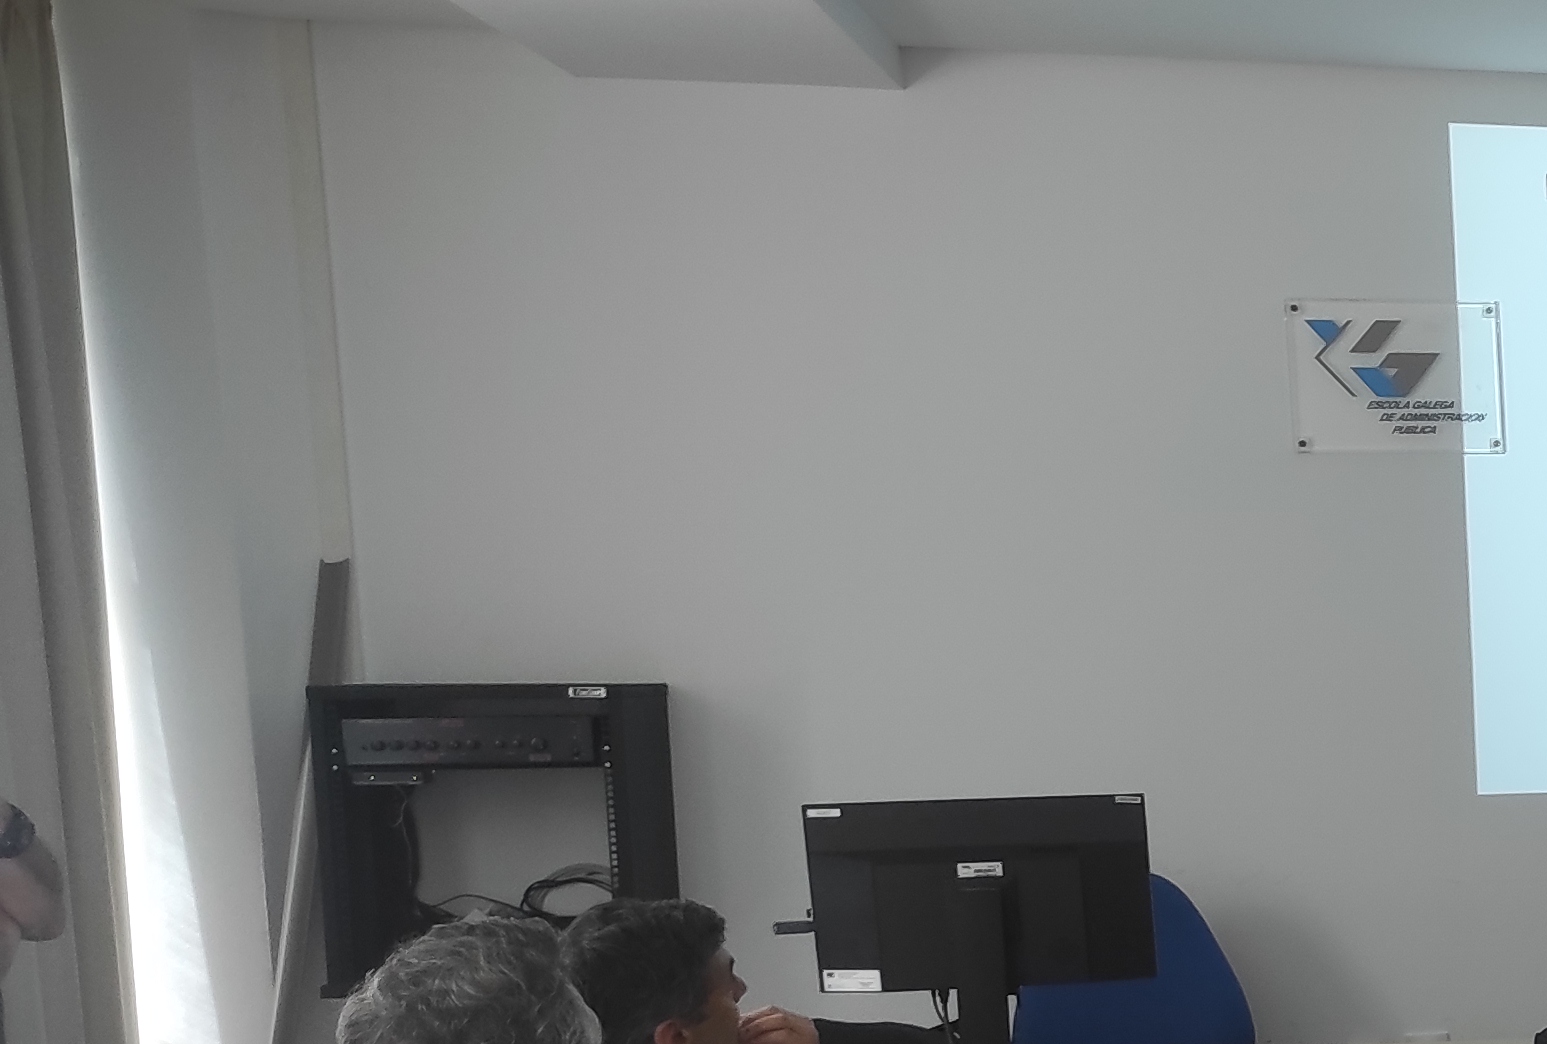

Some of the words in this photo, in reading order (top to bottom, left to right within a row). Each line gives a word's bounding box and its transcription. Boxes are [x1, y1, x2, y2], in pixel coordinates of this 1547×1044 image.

[1366, 400, 1411, 410] ESCOLA
[1412, 400, 1455, 410] GALEGA
[1379, 412, 1398, 422] DE
